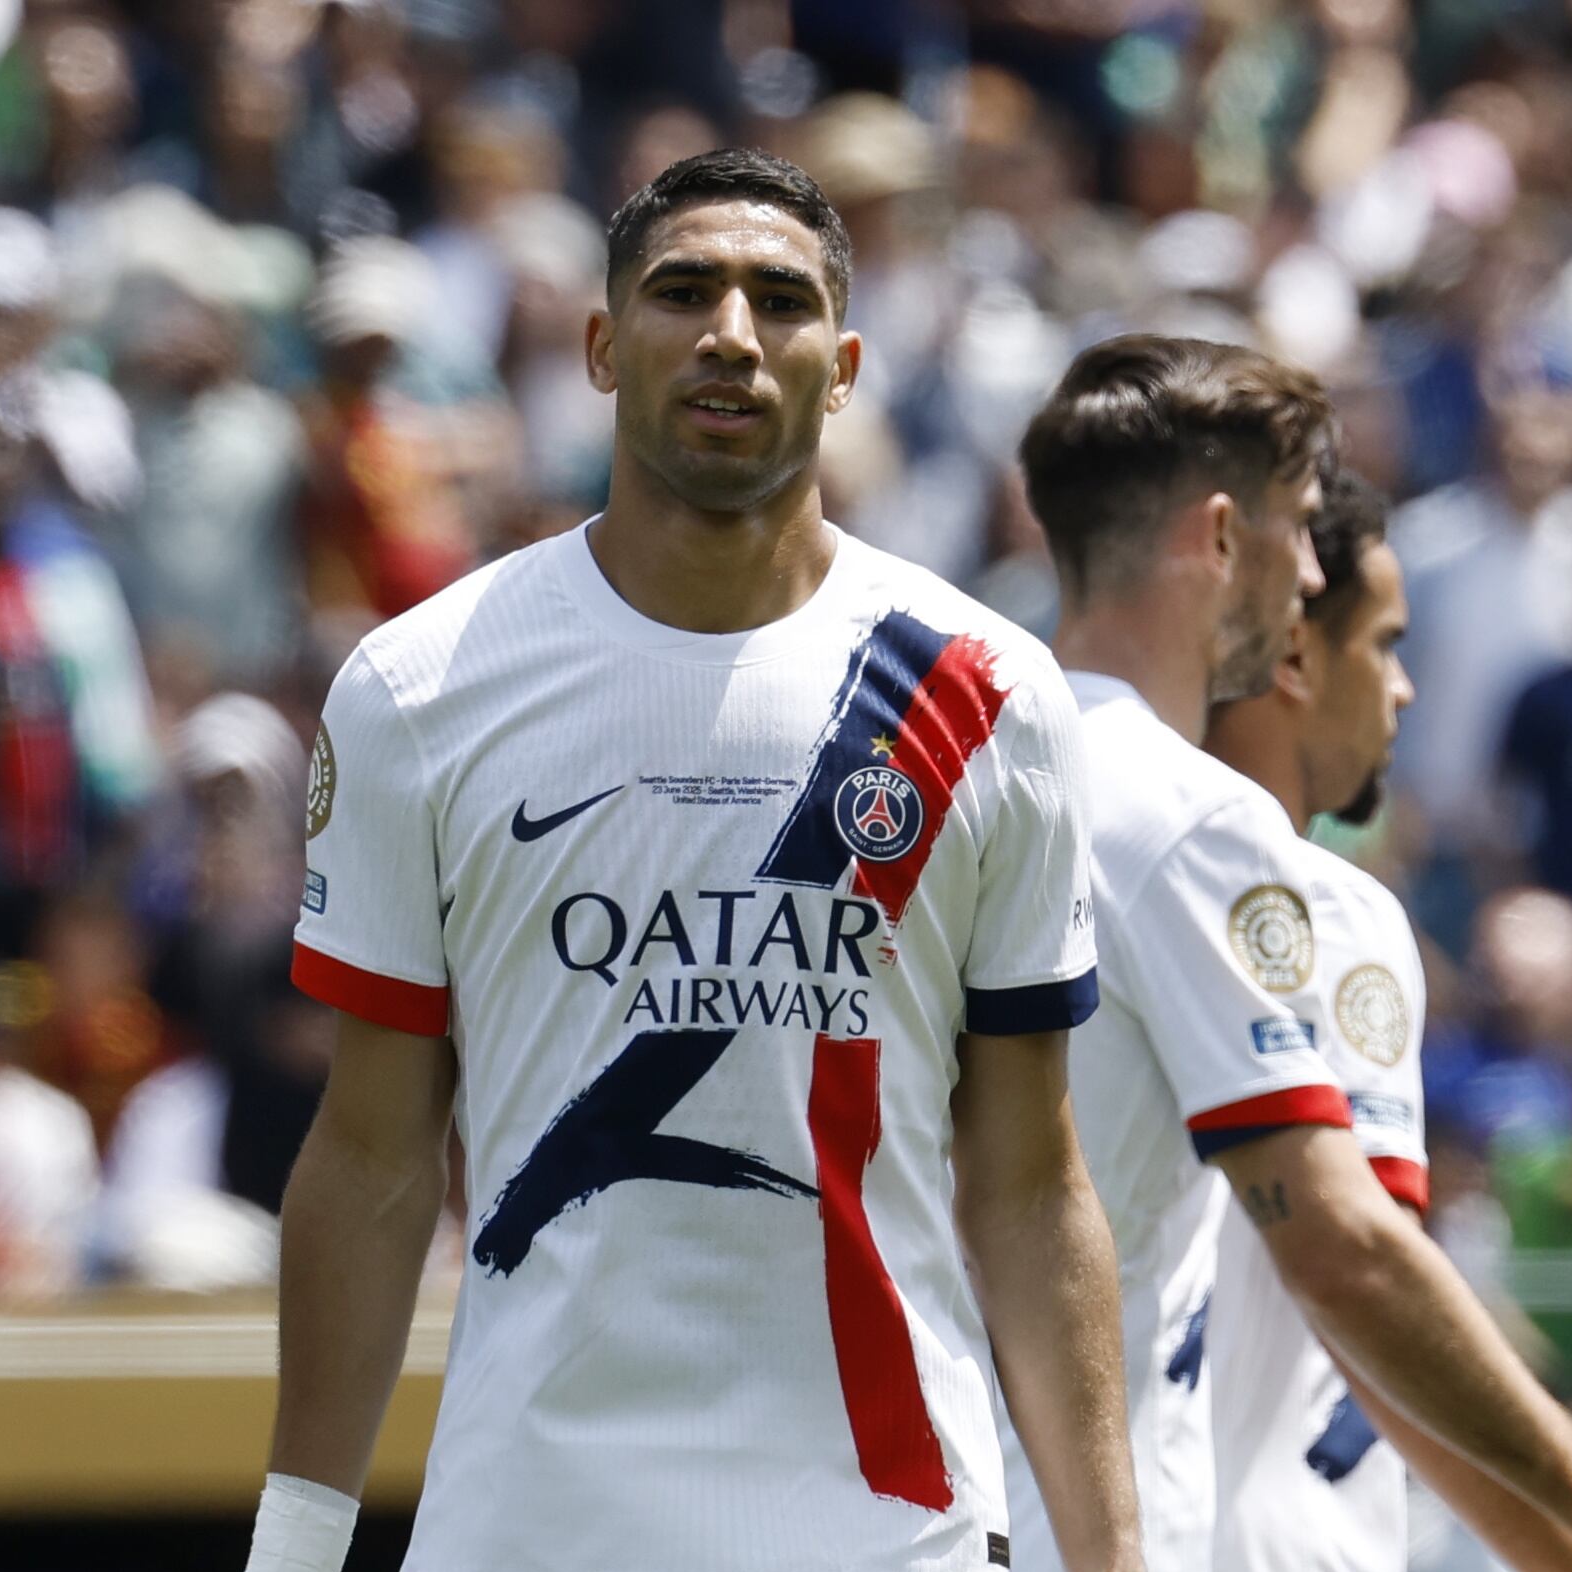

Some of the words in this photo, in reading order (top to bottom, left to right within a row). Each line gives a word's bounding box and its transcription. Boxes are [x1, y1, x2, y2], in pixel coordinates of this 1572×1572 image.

[639, 776, 667, 785] Seattle
[668, 776, 704, 785] Sounders
[704, 776, 716, 785] FC
[721, 776, 741, 785] Paris
[851, 771, 911, 799] PARIS
[651, 785, 663, 794] 23
[663, 785, 681, 794] June
[682, 785, 702, 795] 2025
[737, 786, 781, 797] Washington
[672, 795, 696, 805] United
[696, 796, 720, 805] States
[721, 796, 730, 805] of
[730, 796, 762, 805] America
[551, 889, 879, 988] QATAR
[623, 977, 870, 1036] AIRWAYS
